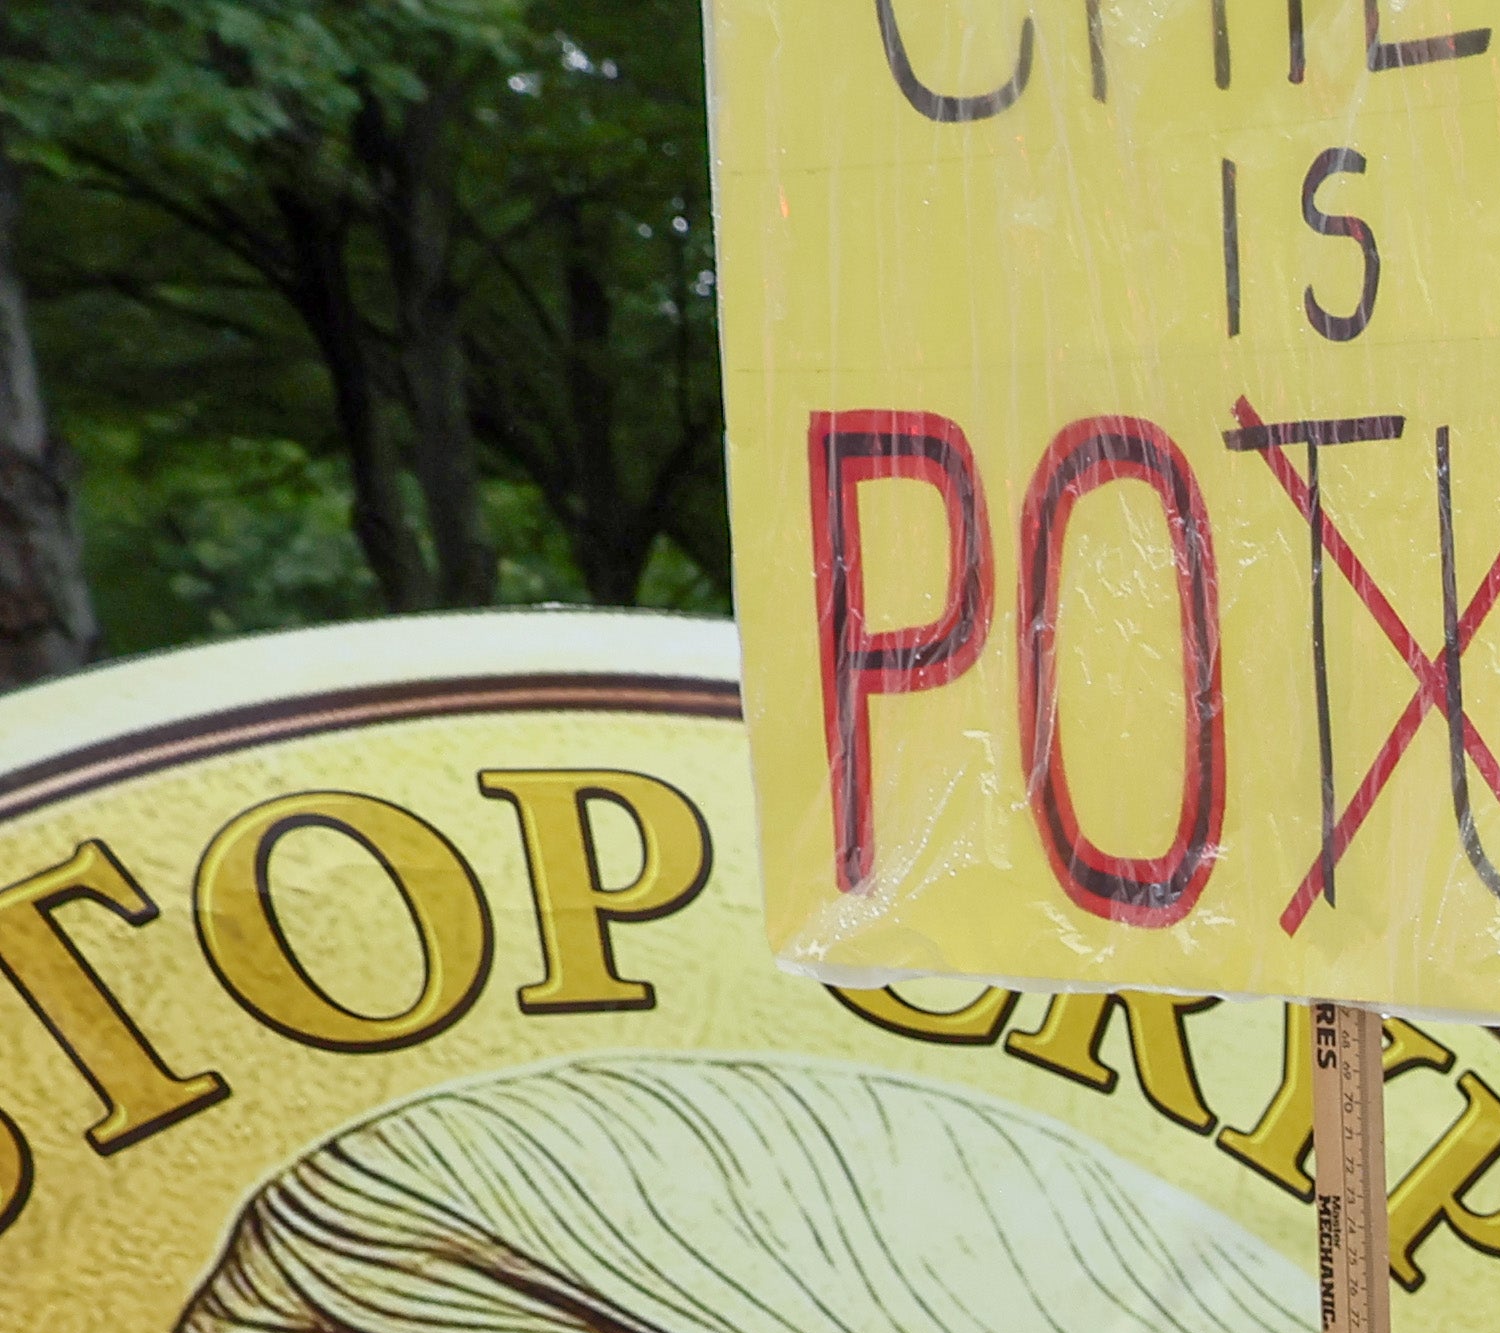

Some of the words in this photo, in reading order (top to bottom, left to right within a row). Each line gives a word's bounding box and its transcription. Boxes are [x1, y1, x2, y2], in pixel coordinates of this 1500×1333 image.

[1221, 146, 1382, 343] IS
[0, 768, 713, 1235] TOP
[1343, 1091, 1354, 1113] 70
[1345, 1157, 1355, 1175] 72
[1331, 1195, 1341, 1251] Master
[1348, 1249, 1358, 1267] 75
[1349, 1278, 1359, 1297] 76
[1350, 1310, 1361, 1328] 77
